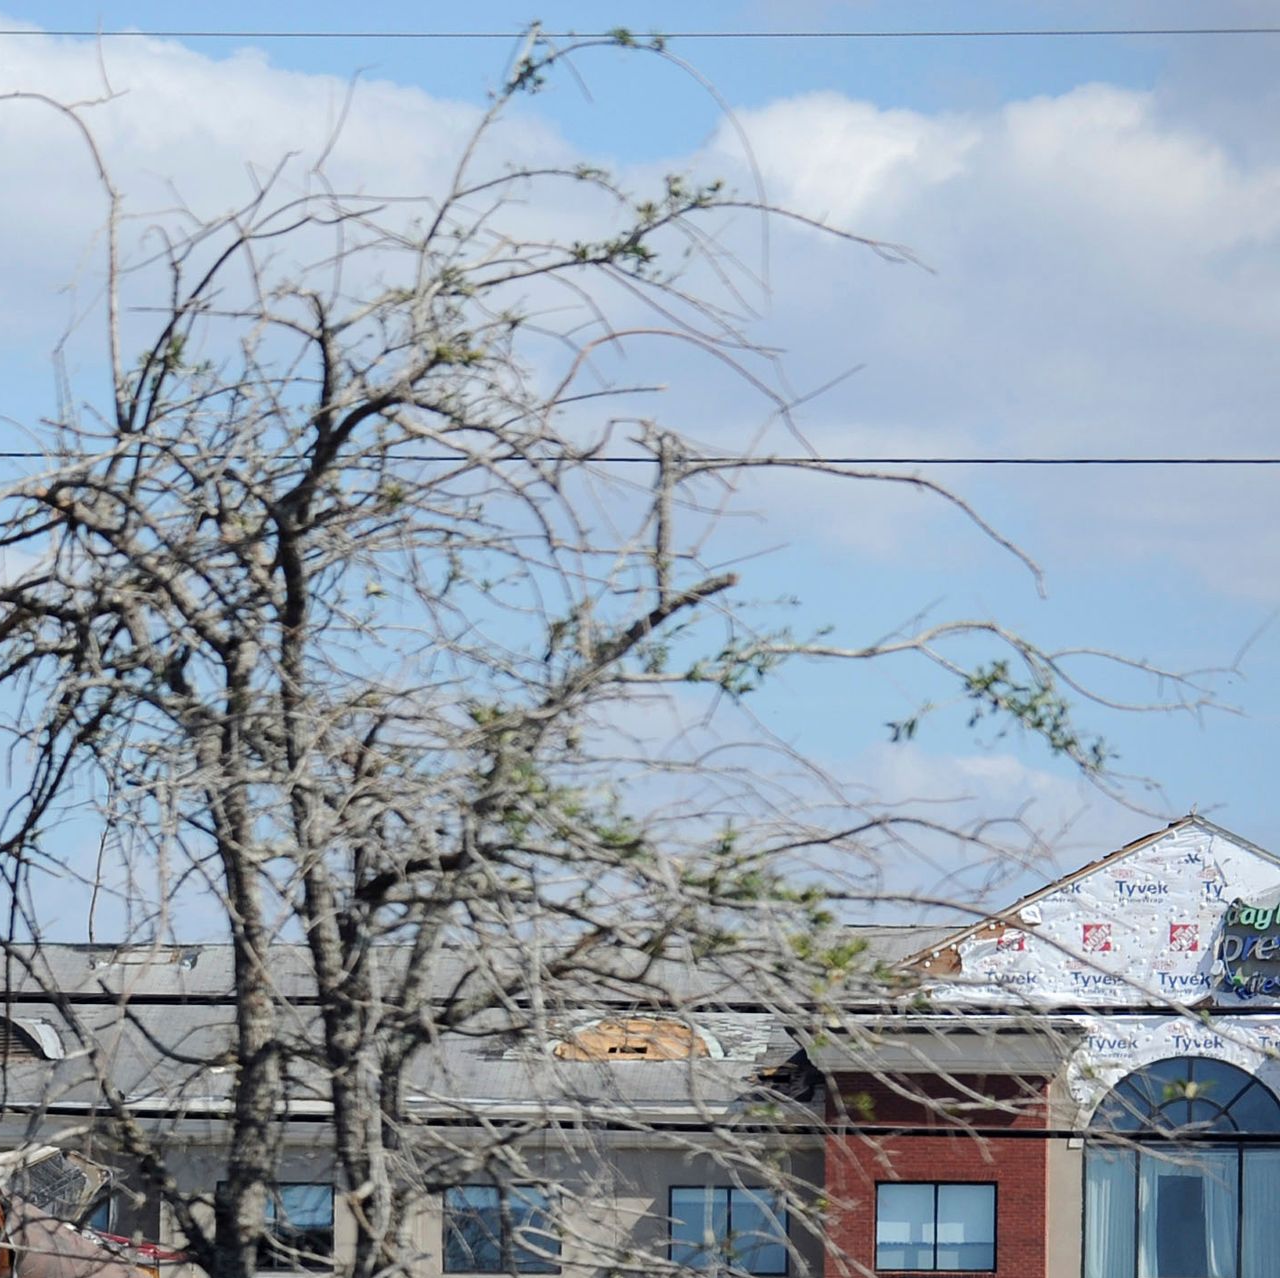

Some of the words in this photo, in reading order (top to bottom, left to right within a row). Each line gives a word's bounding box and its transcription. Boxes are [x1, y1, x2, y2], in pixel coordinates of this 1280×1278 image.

[1115, 880, 1168, 897] Tyvek
[1159, 971, 1211, 989] Tyvek
[1085, 1035, 1138, 1050] Tyvek
